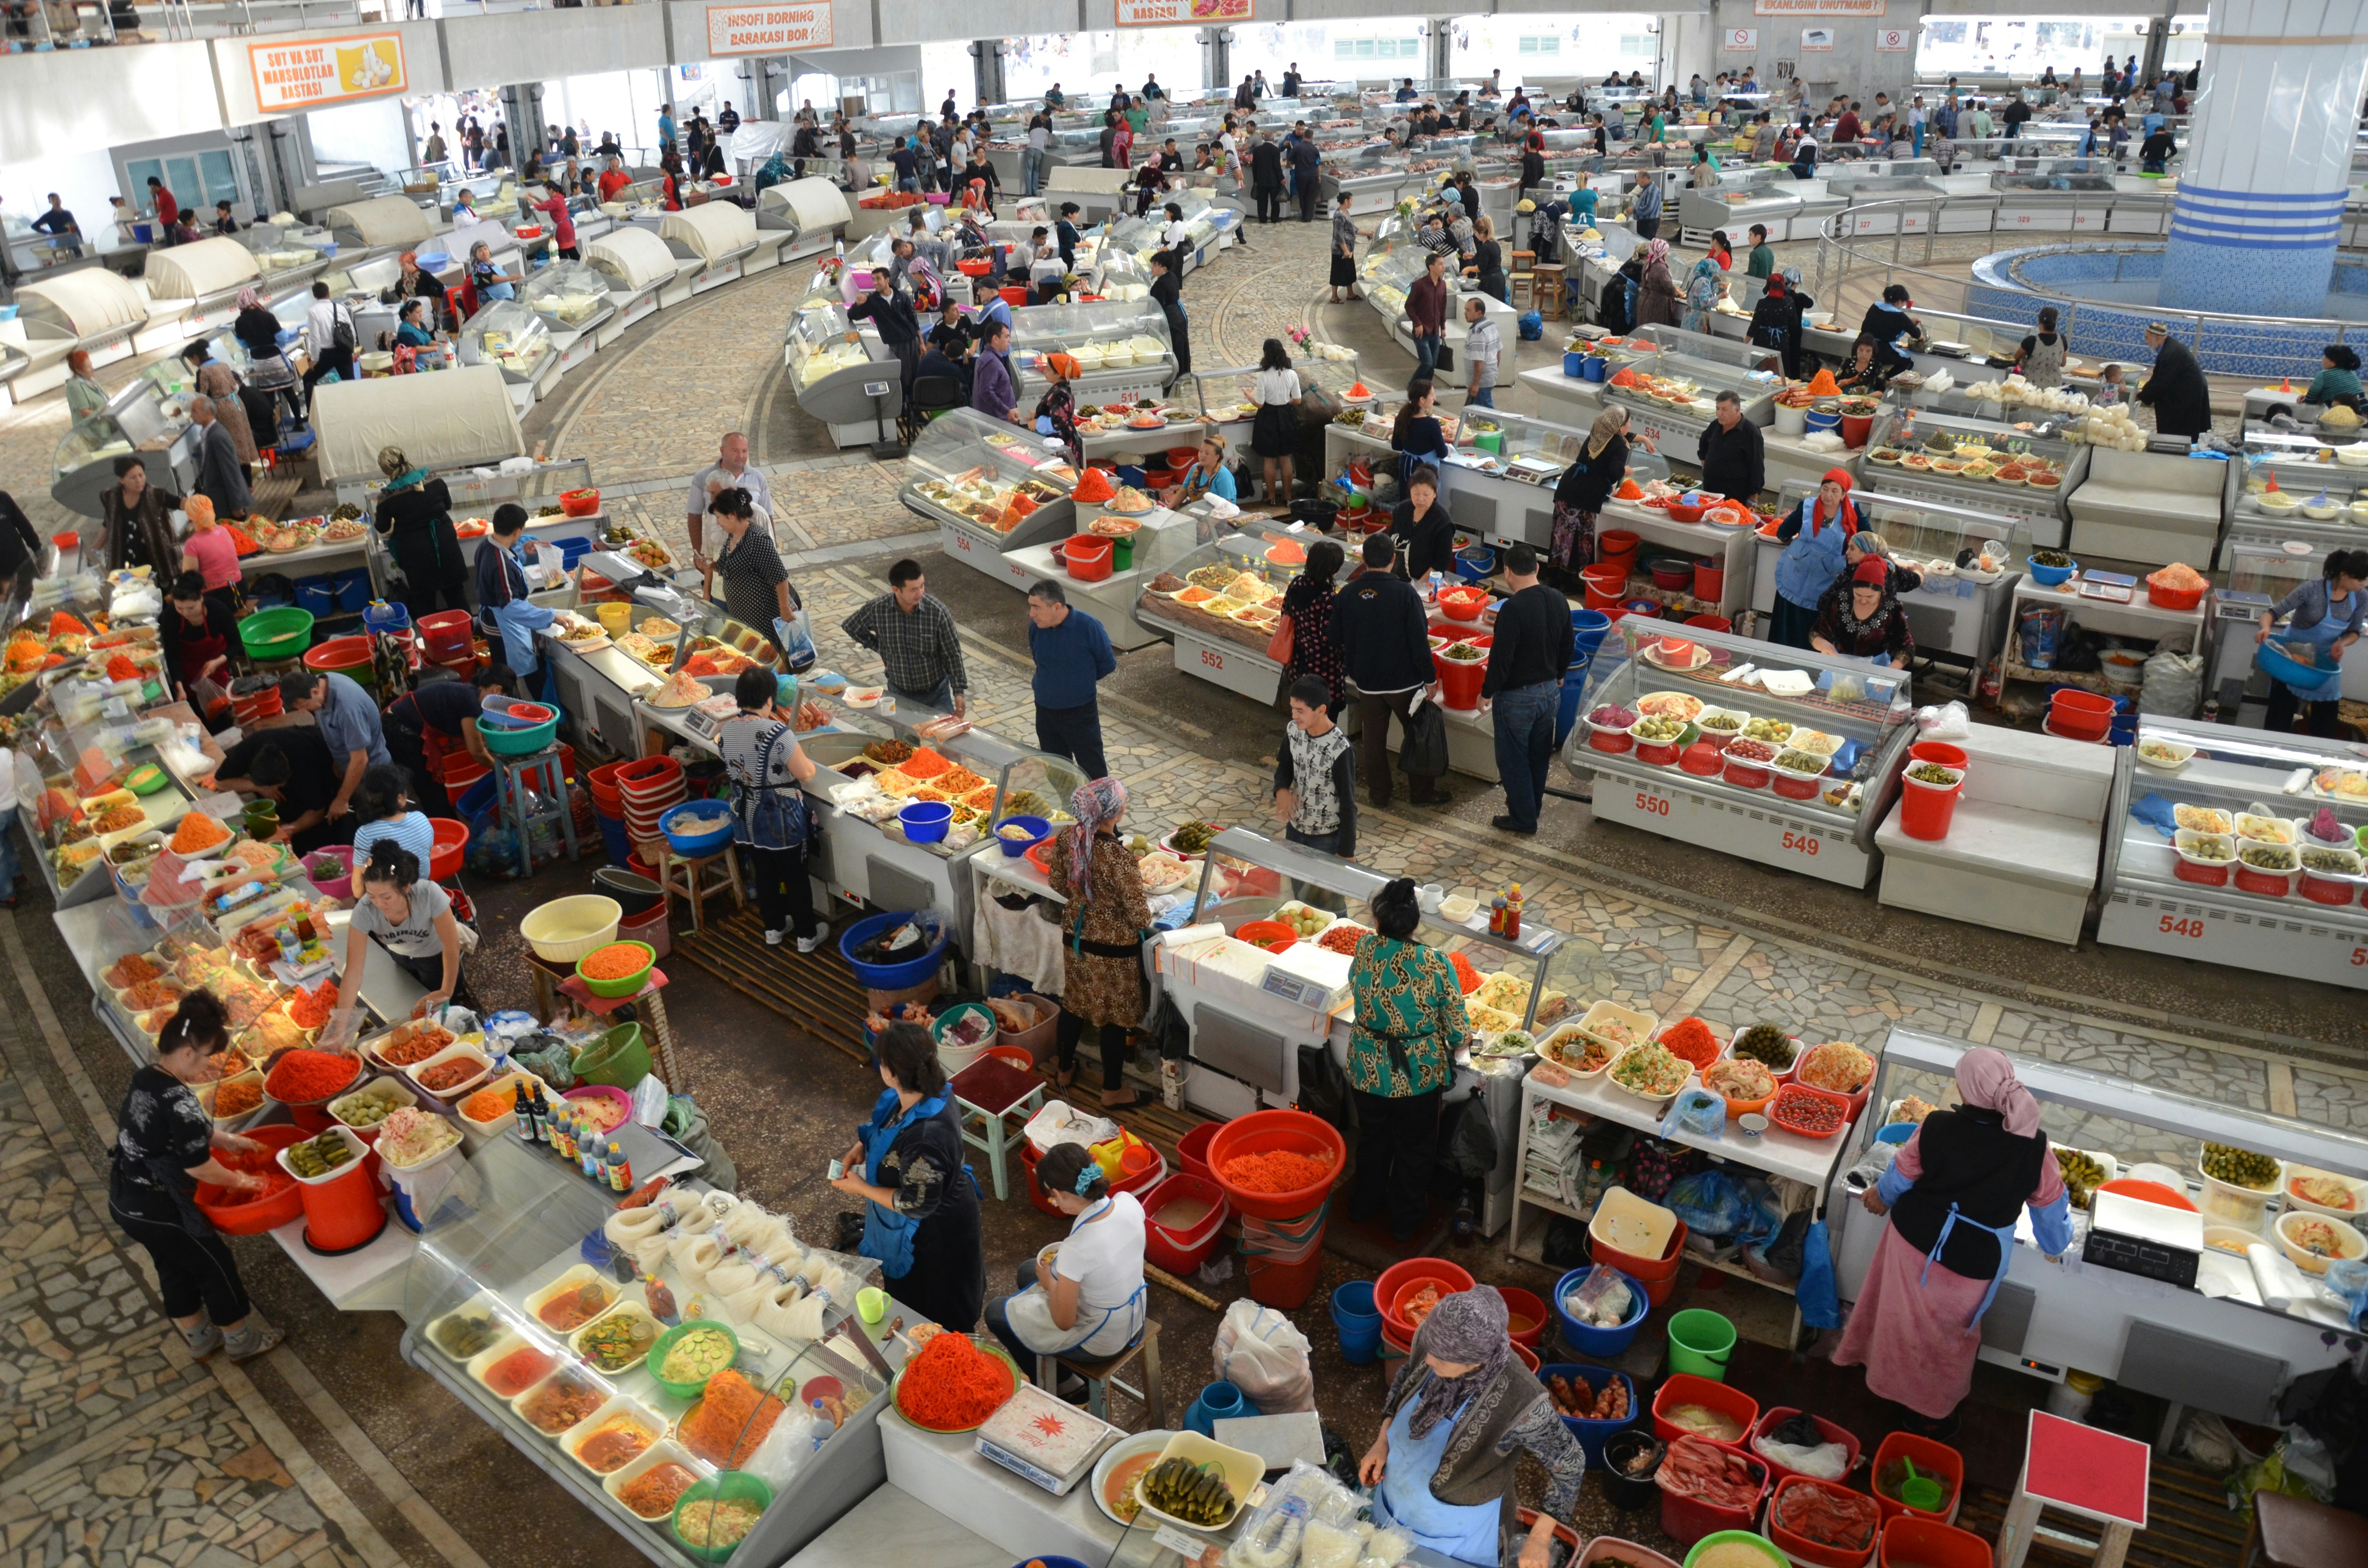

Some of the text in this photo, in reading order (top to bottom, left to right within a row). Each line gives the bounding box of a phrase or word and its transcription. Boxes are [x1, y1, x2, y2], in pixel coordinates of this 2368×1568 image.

[1134, 6, 1176, 19] RASTASI
[1764, 0, 1816, 10] EKANLIGINI
[1819, 0, 1873, 10] UNUTMANG
[728, 10, 814, 27] INSOFI BORNING
[730, 32, 784, 45] BARAKASI
[788, 29, 808, 42] BOR
[267, 48, 323, 67] SUT VA SUT
[281, 81, 322, 99] RASTASI
[195, 315, 204, 323] 454
[110, 342, 120, 350] 455
[1121, 392, 1139, 403] 511
[1645, 427, 1660, 441] 534
[957, 536, 970, 552] 554
[1201, 650, 1223, 670] 552
[1636, 793, 1669, 816] 550
[1782, 832, 1819, 856] 549
[2159, 915, 2204, 938] 548
